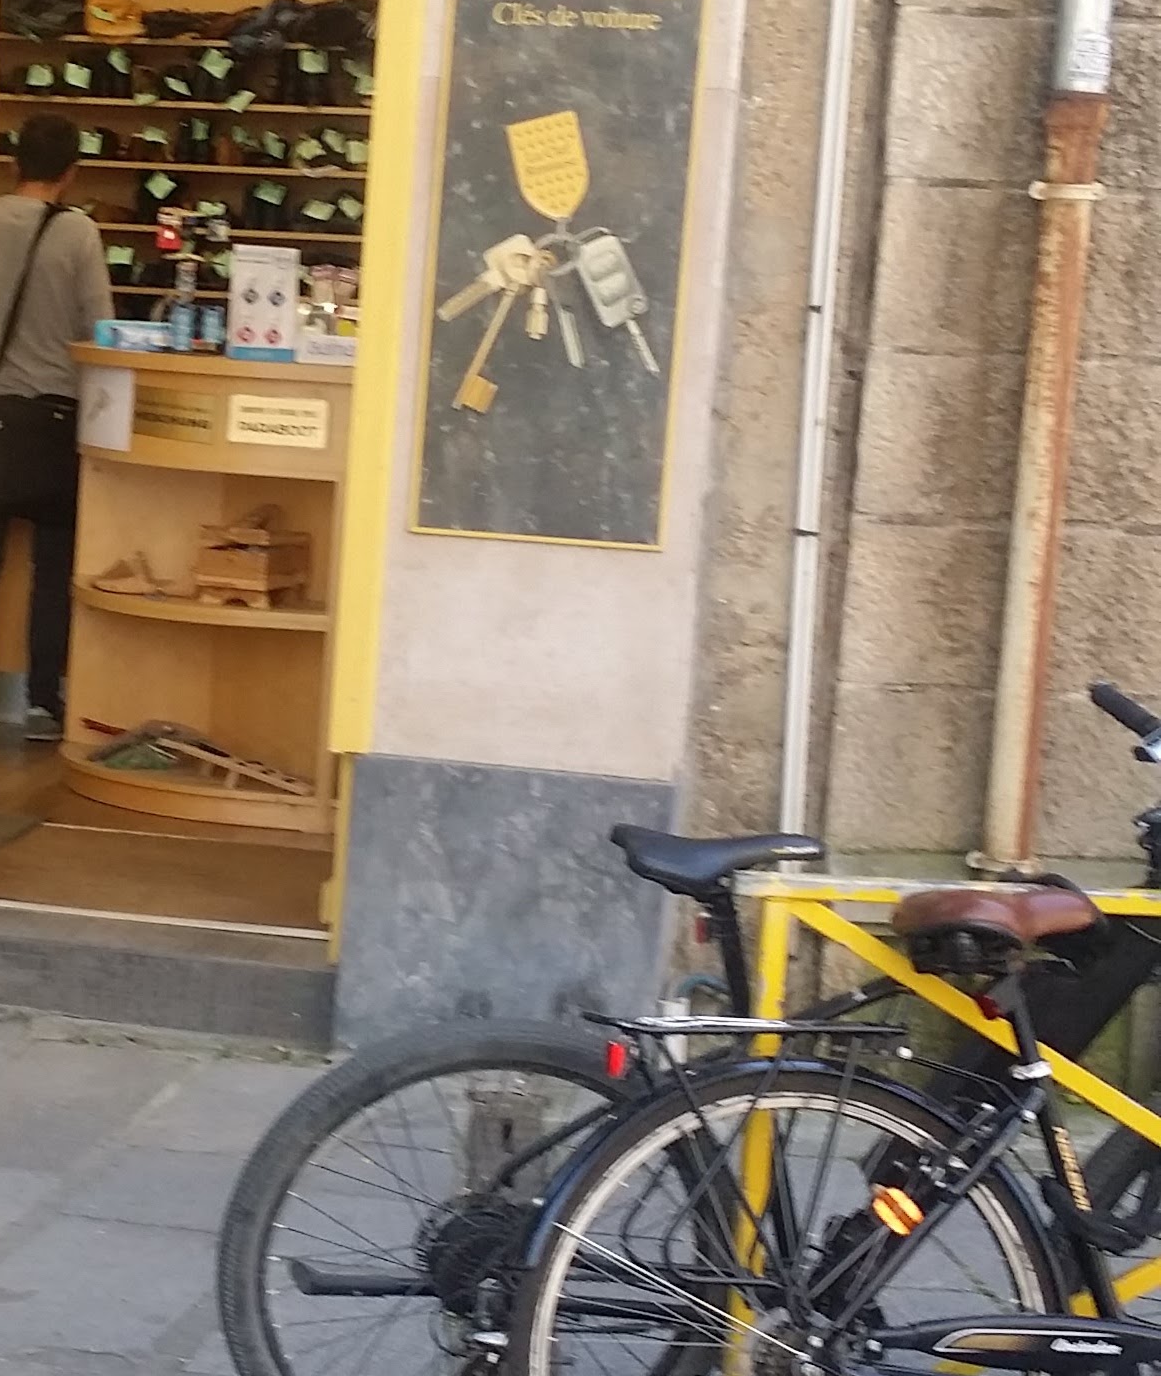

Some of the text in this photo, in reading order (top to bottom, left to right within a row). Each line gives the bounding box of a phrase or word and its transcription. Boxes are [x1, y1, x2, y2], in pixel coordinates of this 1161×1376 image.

[492, 1, 664, 31] Clés de voiture
